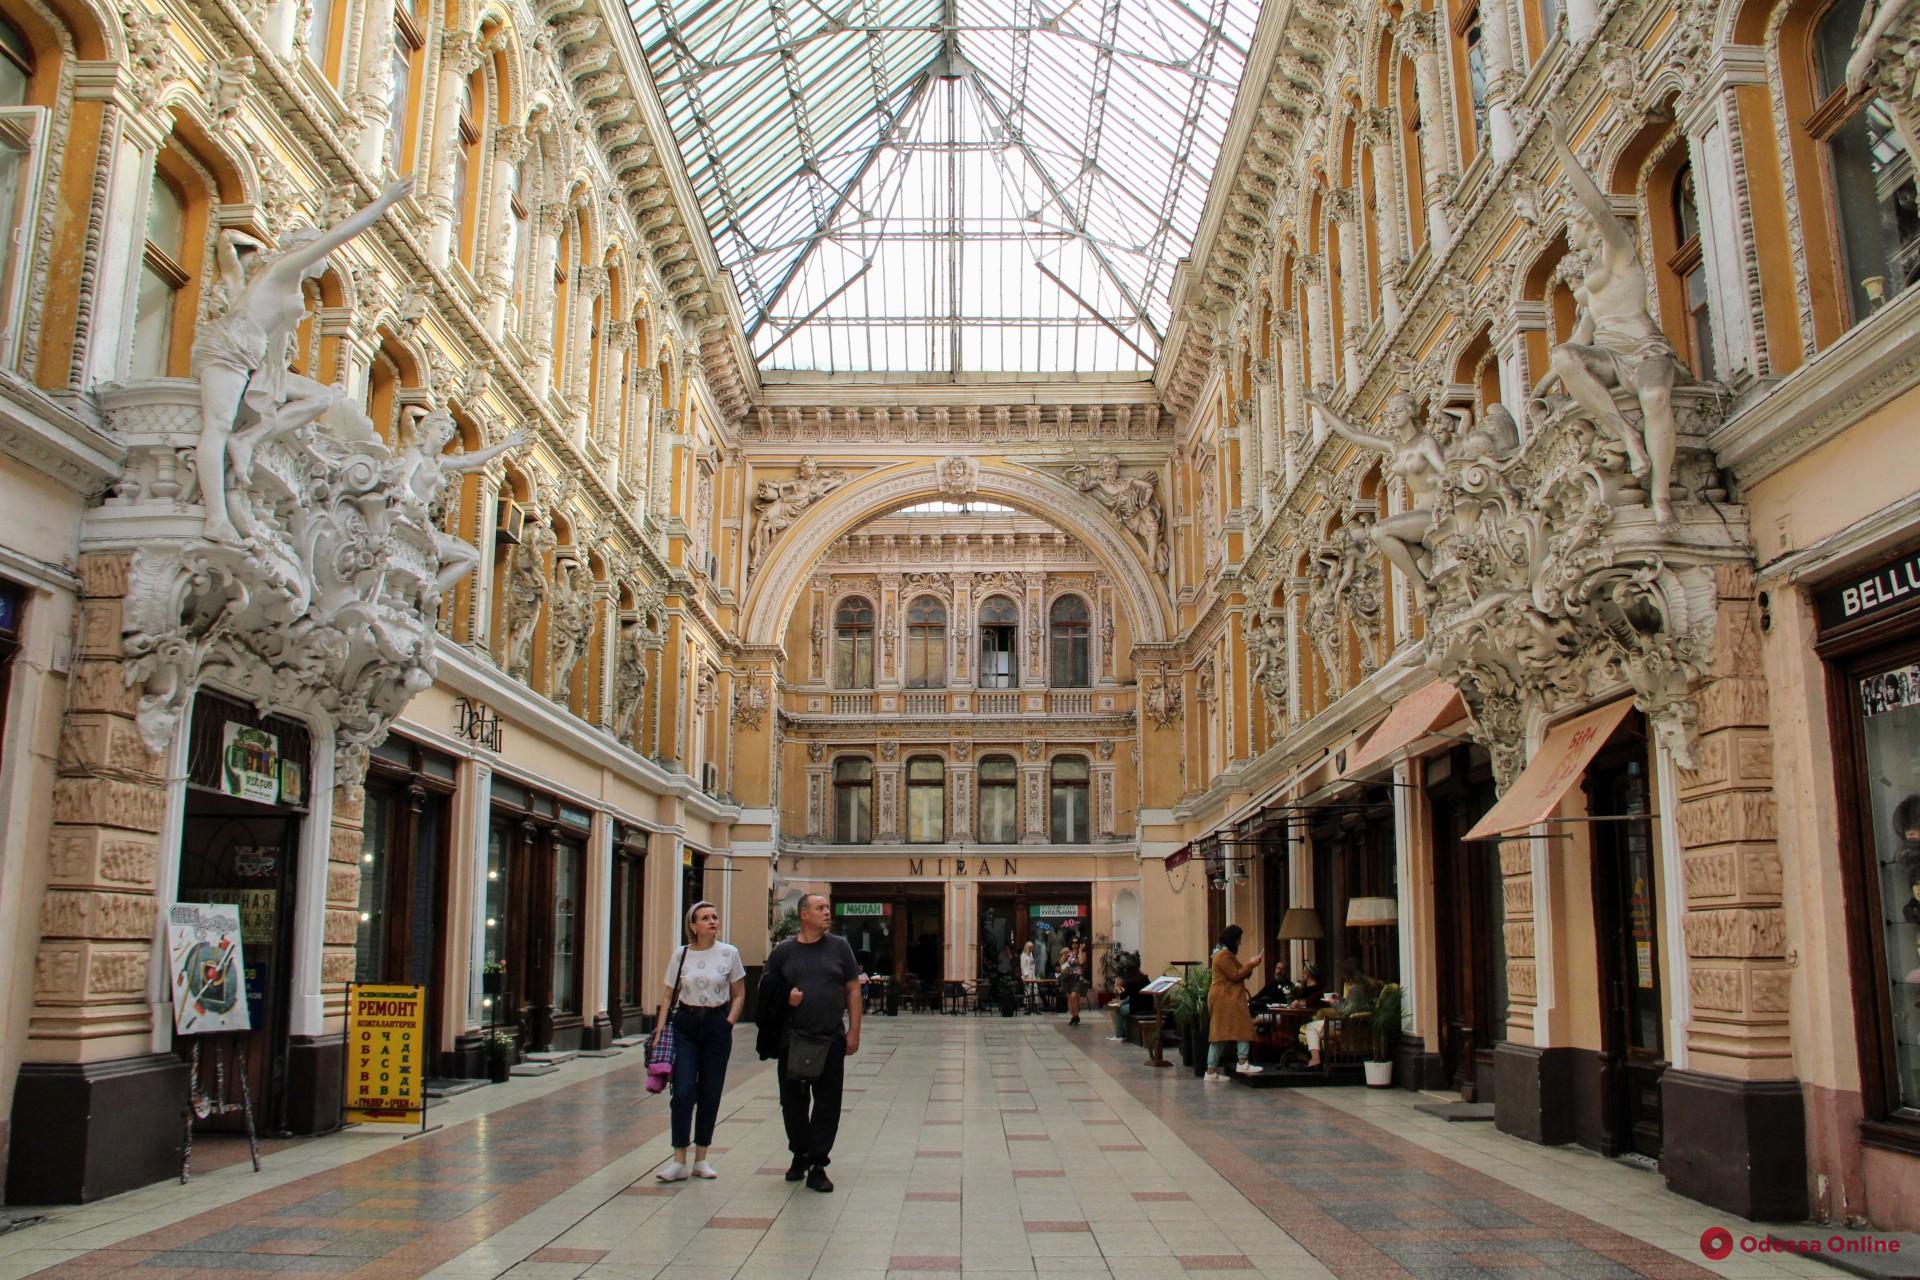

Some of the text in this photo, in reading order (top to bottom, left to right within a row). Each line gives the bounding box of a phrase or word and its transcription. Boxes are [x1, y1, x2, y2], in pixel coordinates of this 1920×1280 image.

[846, 903, 880, 914] МИЛАН
[358, 1000, 418, 1017] РЕМОНТ
[359, 1031, 371, 1095] ОБУВИ
[380, 1032, 390, 1096] ЧАСОВ
